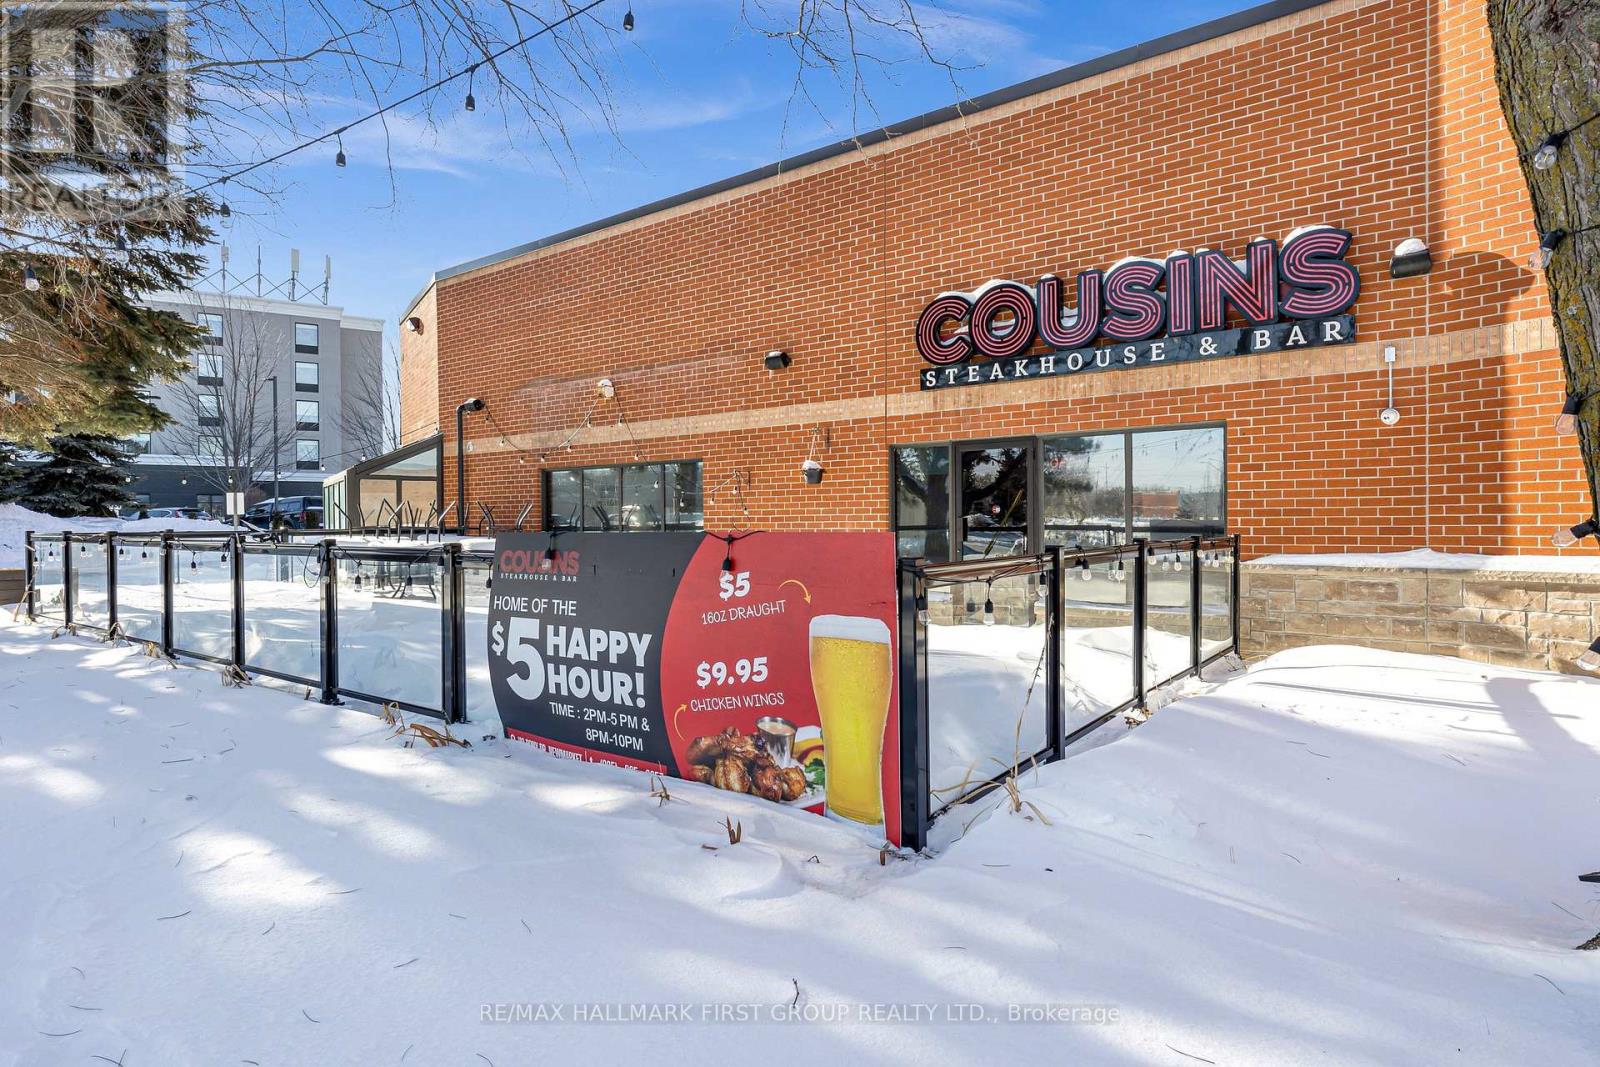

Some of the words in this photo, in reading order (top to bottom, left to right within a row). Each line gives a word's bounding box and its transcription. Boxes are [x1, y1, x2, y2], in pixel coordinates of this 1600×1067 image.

[915, 228, 1360, 366] COUSINS
[925, 342, 1166, 387] STEAKHOUSE
[1199, 336, 1217, 355] &
[1253, 320, 1344, 351] BAR
[500, 573, 548, 581] STEAKHOUSE
[719, 570, 750, 601] $5
[494, 595, 528, 612] HOME
[532, 598, 548, 613] OF
[552, 599, 576, 616] THE
[729, 600, 786, 621] DRAUGHT
[546, 624, 652, 667] HAPPY
[547, 663, 646, 708] HOUR!
[696, 656, 768, 689] $9.95
[549, 701, 575, 719] TIME
[620, 714, 638, 730] PM
[641, 717, 650, 731] &
[690, 695, 742, 712] CHICKEN
[743, 692, 785, 708] WINGS
[585, 728, 643, 751] 8PM-10PM
